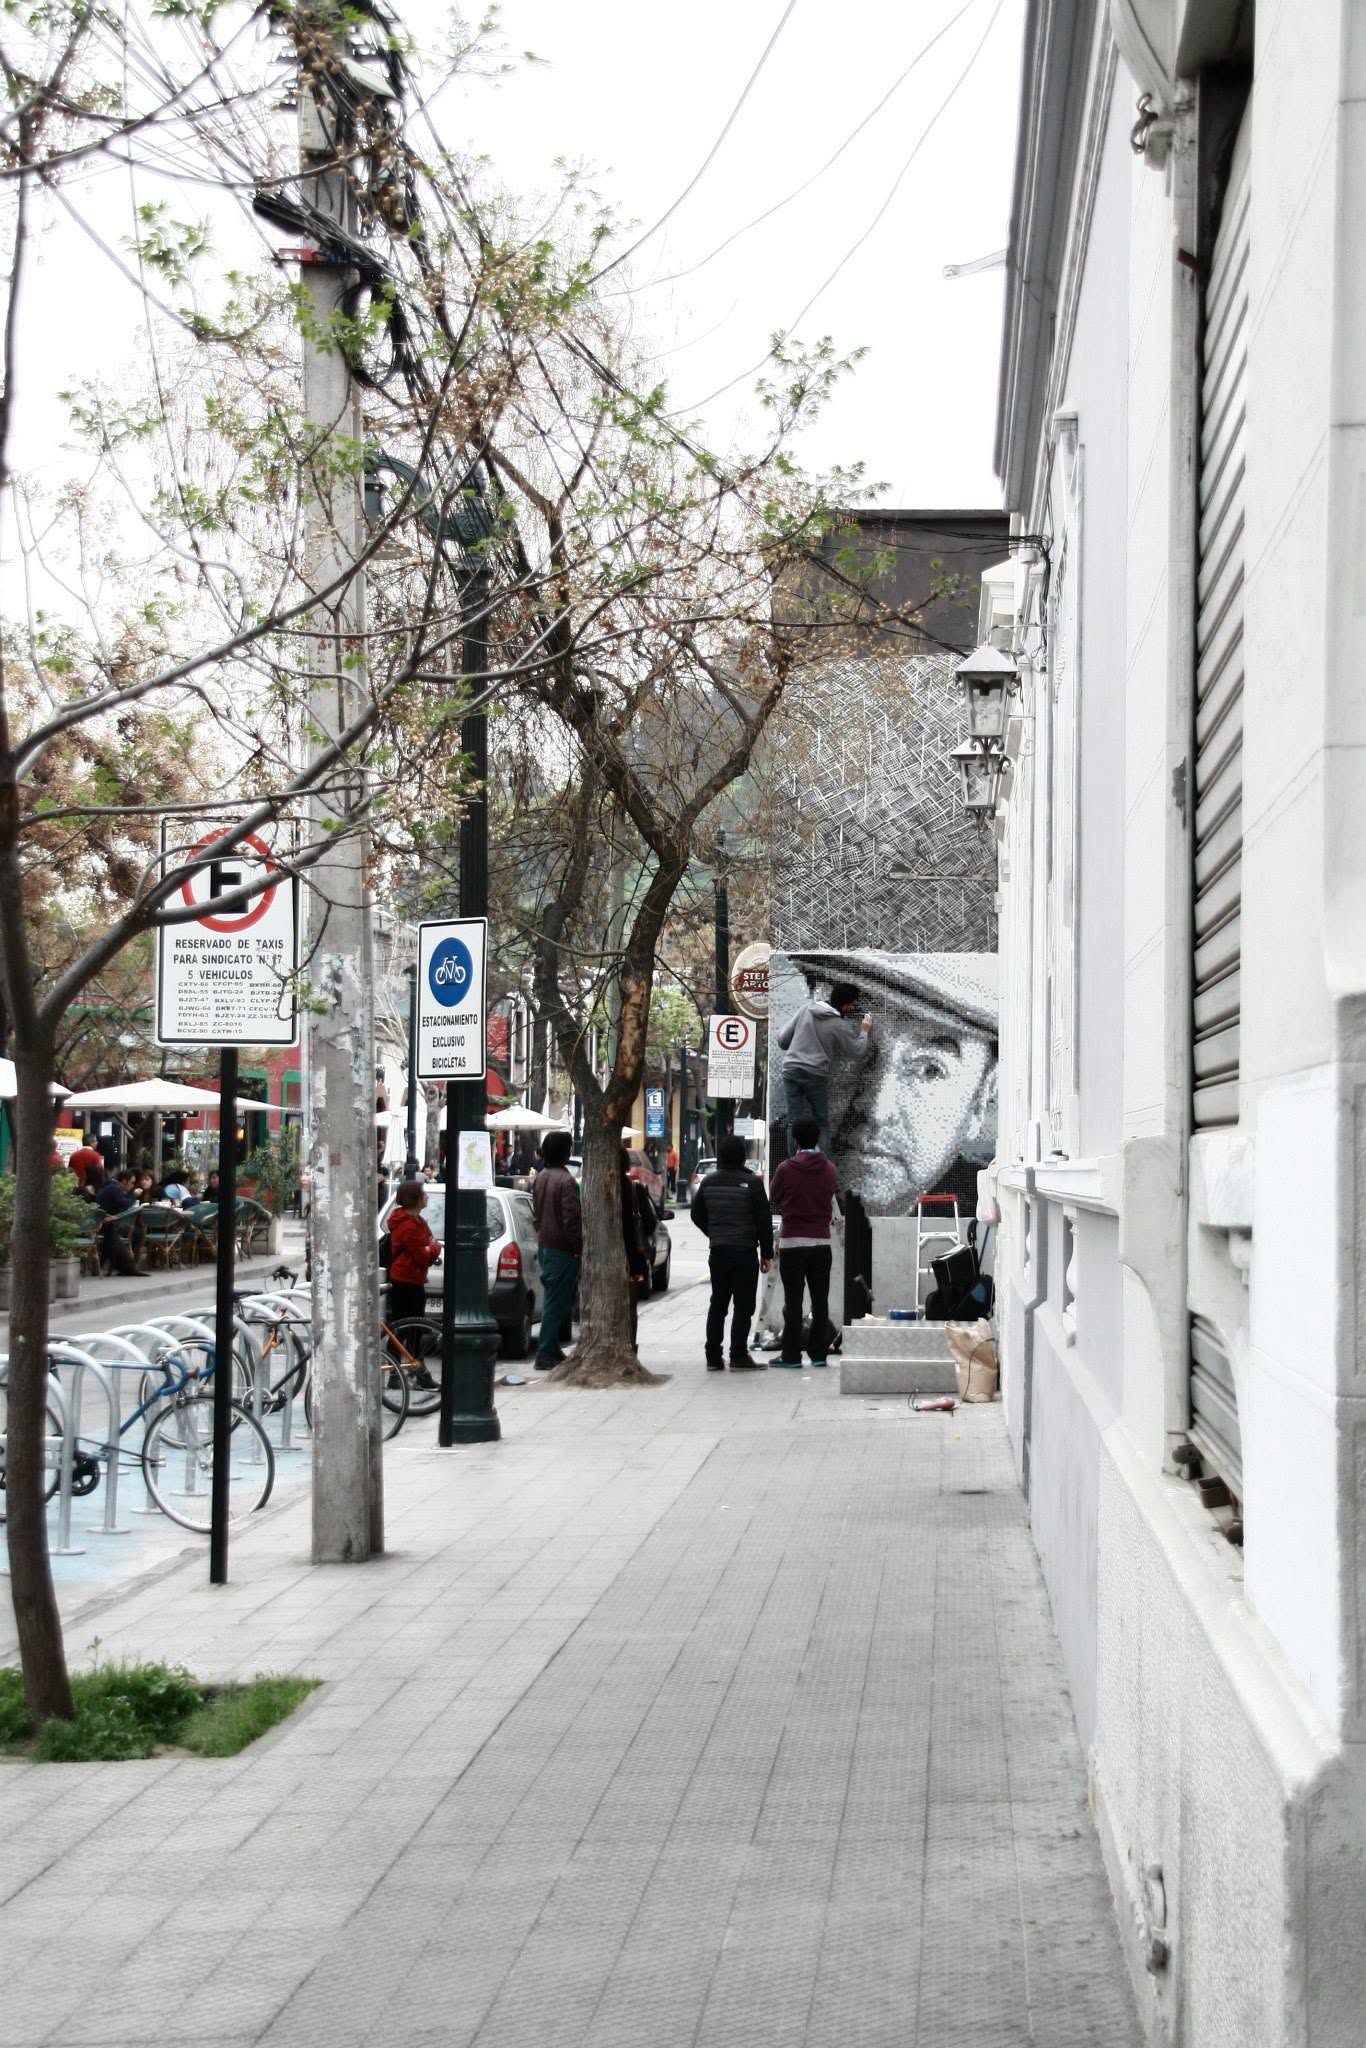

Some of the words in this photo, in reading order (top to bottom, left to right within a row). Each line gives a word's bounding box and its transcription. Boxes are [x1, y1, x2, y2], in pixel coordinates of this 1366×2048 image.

[176, 939, 232, 949] RESERVADO
[238, 939, 250, 949] DE
[256, 939, 284, 949] TAXIS
[174, 954, 198, 964] PARA
[202, 954, 253, 964] SINDICATO
[188, 970, 193, 980] 5
[200, 970, 253, 980] VEHICULOS
[423, 1013, 478, 1027] ESTACIONAMIENTO
[726, 1024, 739, 1042] E
[433, 1036, 465, 1047] EXCLUSIVO
[433, 1057, 467, 1068] BICICLETAS
